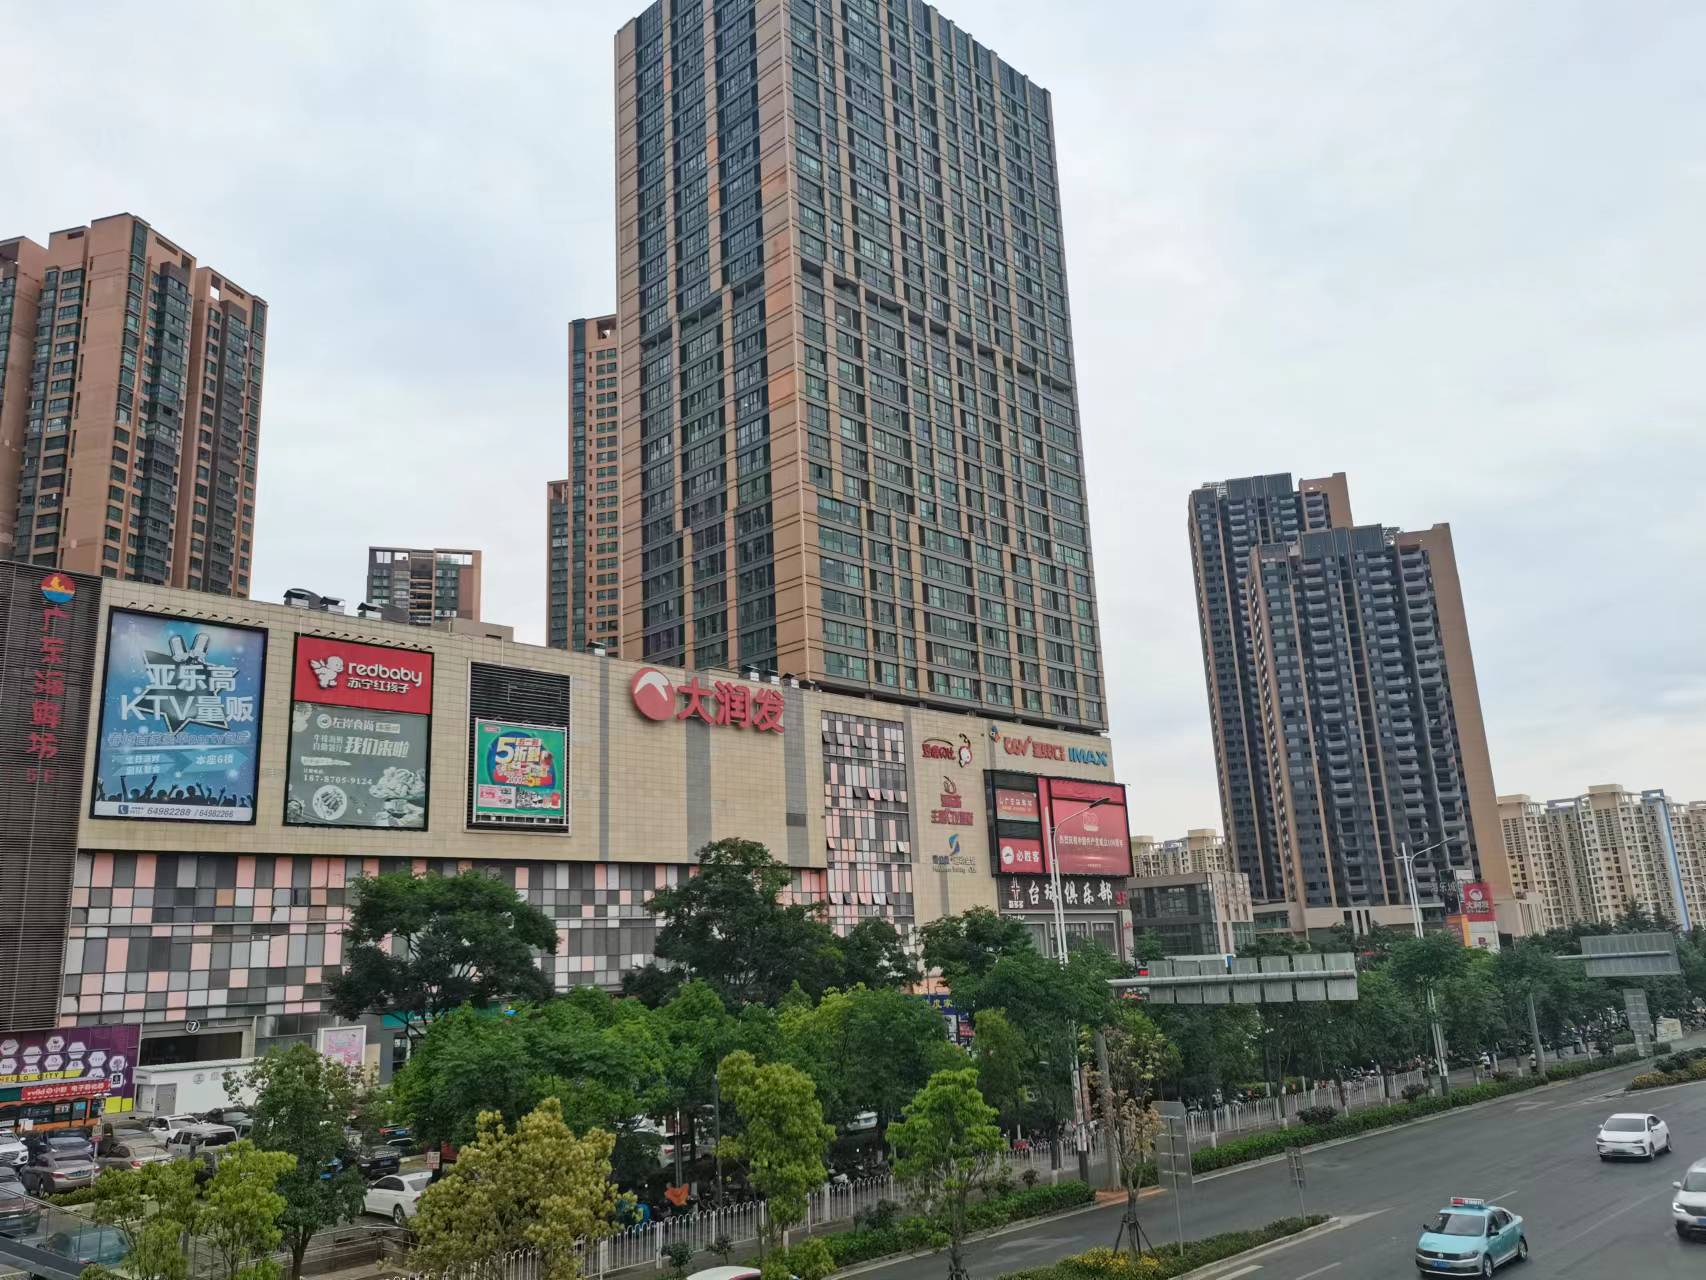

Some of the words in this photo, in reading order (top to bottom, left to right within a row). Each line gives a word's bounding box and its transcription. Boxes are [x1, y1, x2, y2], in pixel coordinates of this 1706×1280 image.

[147, 664, 240, 692] 亚乐高
[347, 677, 410, 694] 苏宁红孩子
[348, 661, 423, 687] redbaby
[121, 694, 254, 722] KTV量贩
[676, 677, 784, 734] 大润发
[344, 736, 409, 758] 我们来啦
[1068, 747, 1108, 767] IMAX
[1016, 849, 1040, 863] 必胜客
[1028, 880, 1113, 906] 台球俱乐部
